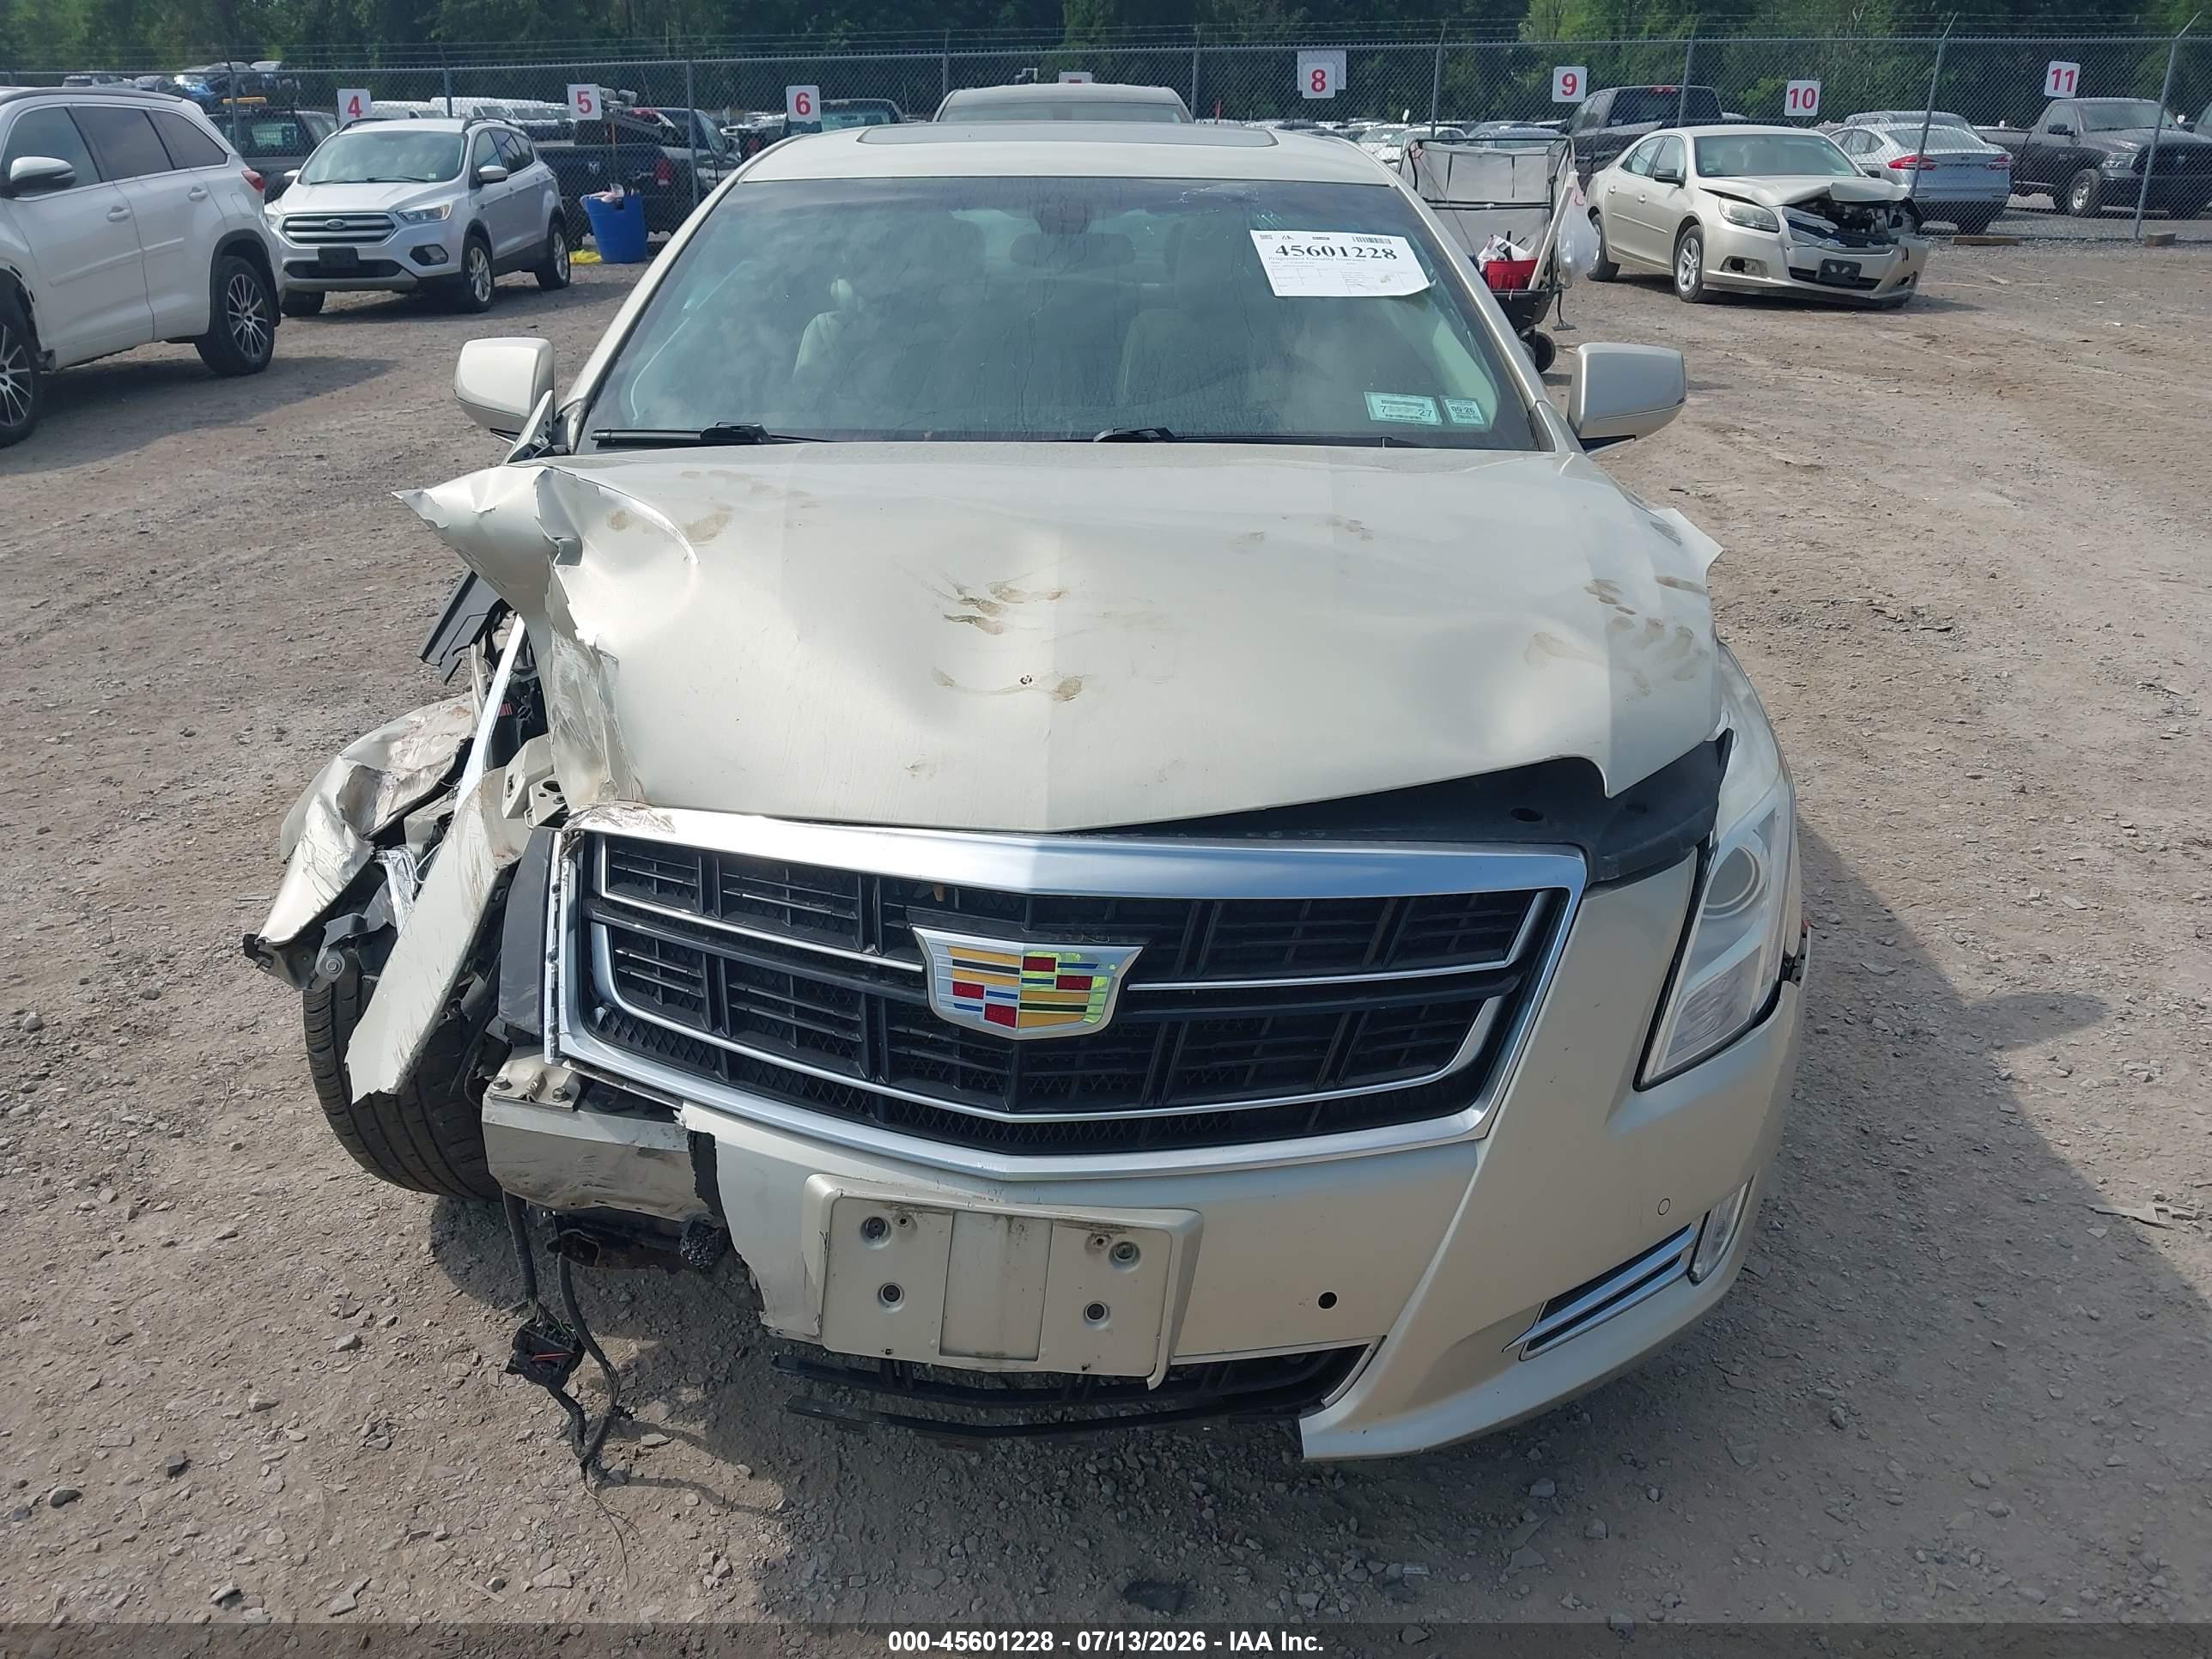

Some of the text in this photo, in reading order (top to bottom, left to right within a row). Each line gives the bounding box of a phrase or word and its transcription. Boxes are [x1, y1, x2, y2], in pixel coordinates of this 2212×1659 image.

[1310, 69, 1327, 93] 8
[1561, 72, 1577, 96] 9
[2051, 68, 2075, 92] 11
[347, 95, 363, 118] 4
[576, 90, 592, 114] 5
[795, 91, 811, 116] 6
[1790, 88, 1816, 109] 10
[1274, 244, 1398, 260] 45601228
[1418, 408, 1432, 417] 27
